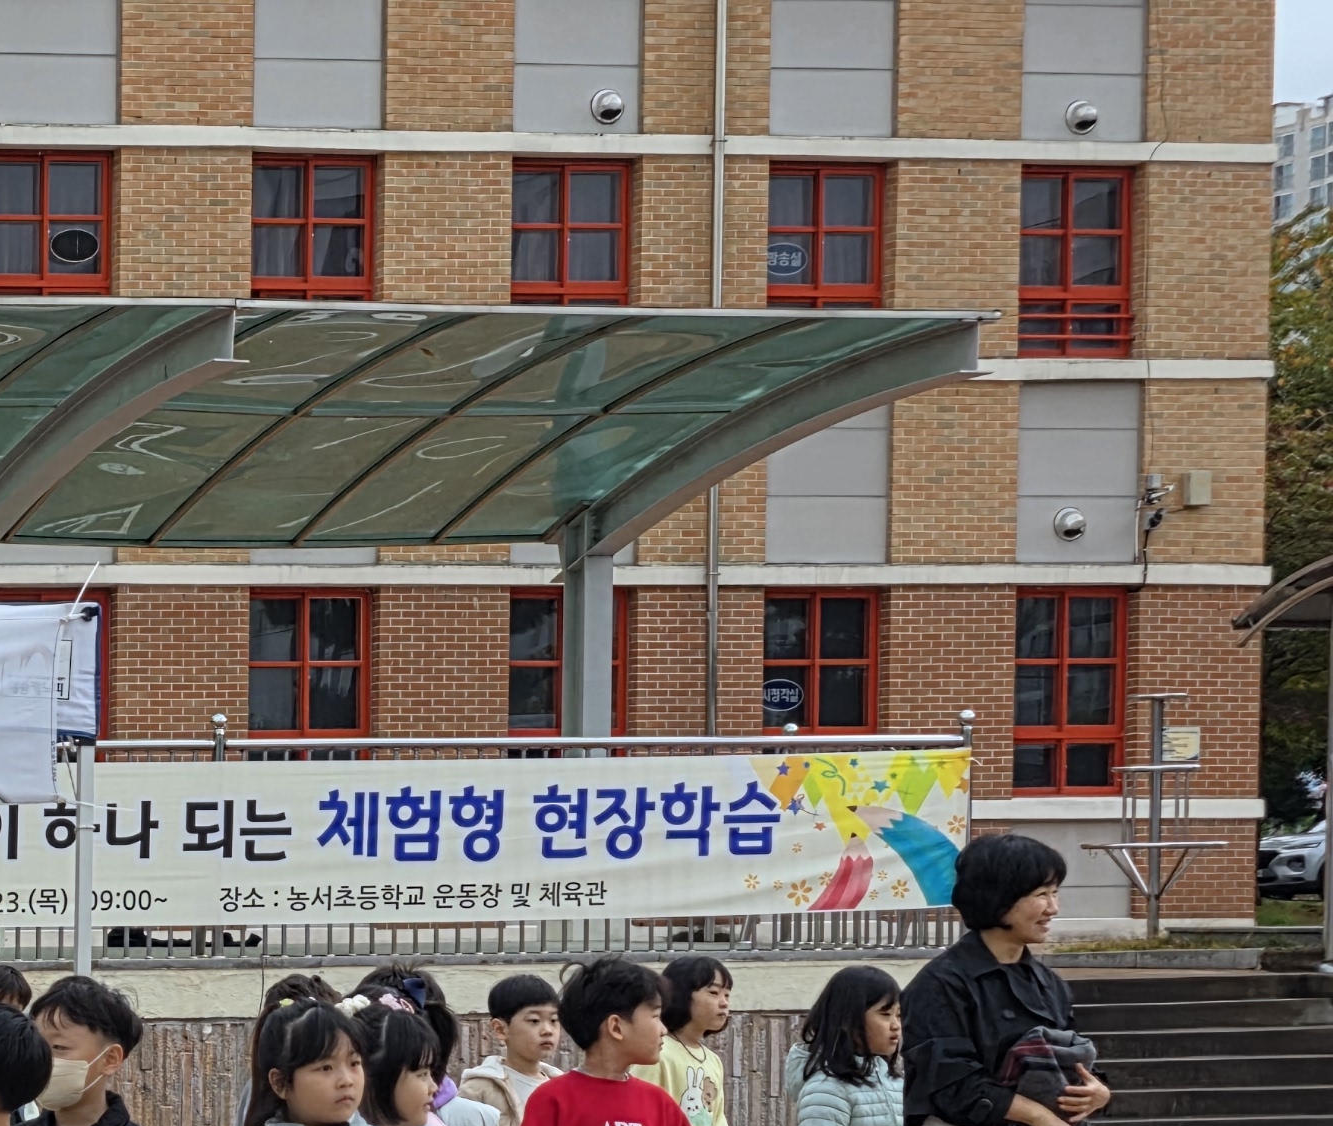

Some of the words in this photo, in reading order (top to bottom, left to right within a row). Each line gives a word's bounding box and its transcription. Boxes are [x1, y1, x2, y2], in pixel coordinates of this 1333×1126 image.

[43, 799, 159, 860] 하나
[182, 799, 293, 862] 되는
[316, 785, 505, 862] 체험형
[533, 780, 781, 860] 현장학습
[219, 886, 266, 912] 장소
[286, 884, 426, 911] 농서초등학교
[432, 882, 503, 909] 운동장
[510, 881, 531, 908] 및
[538, 880, 607, 907] 체육관
